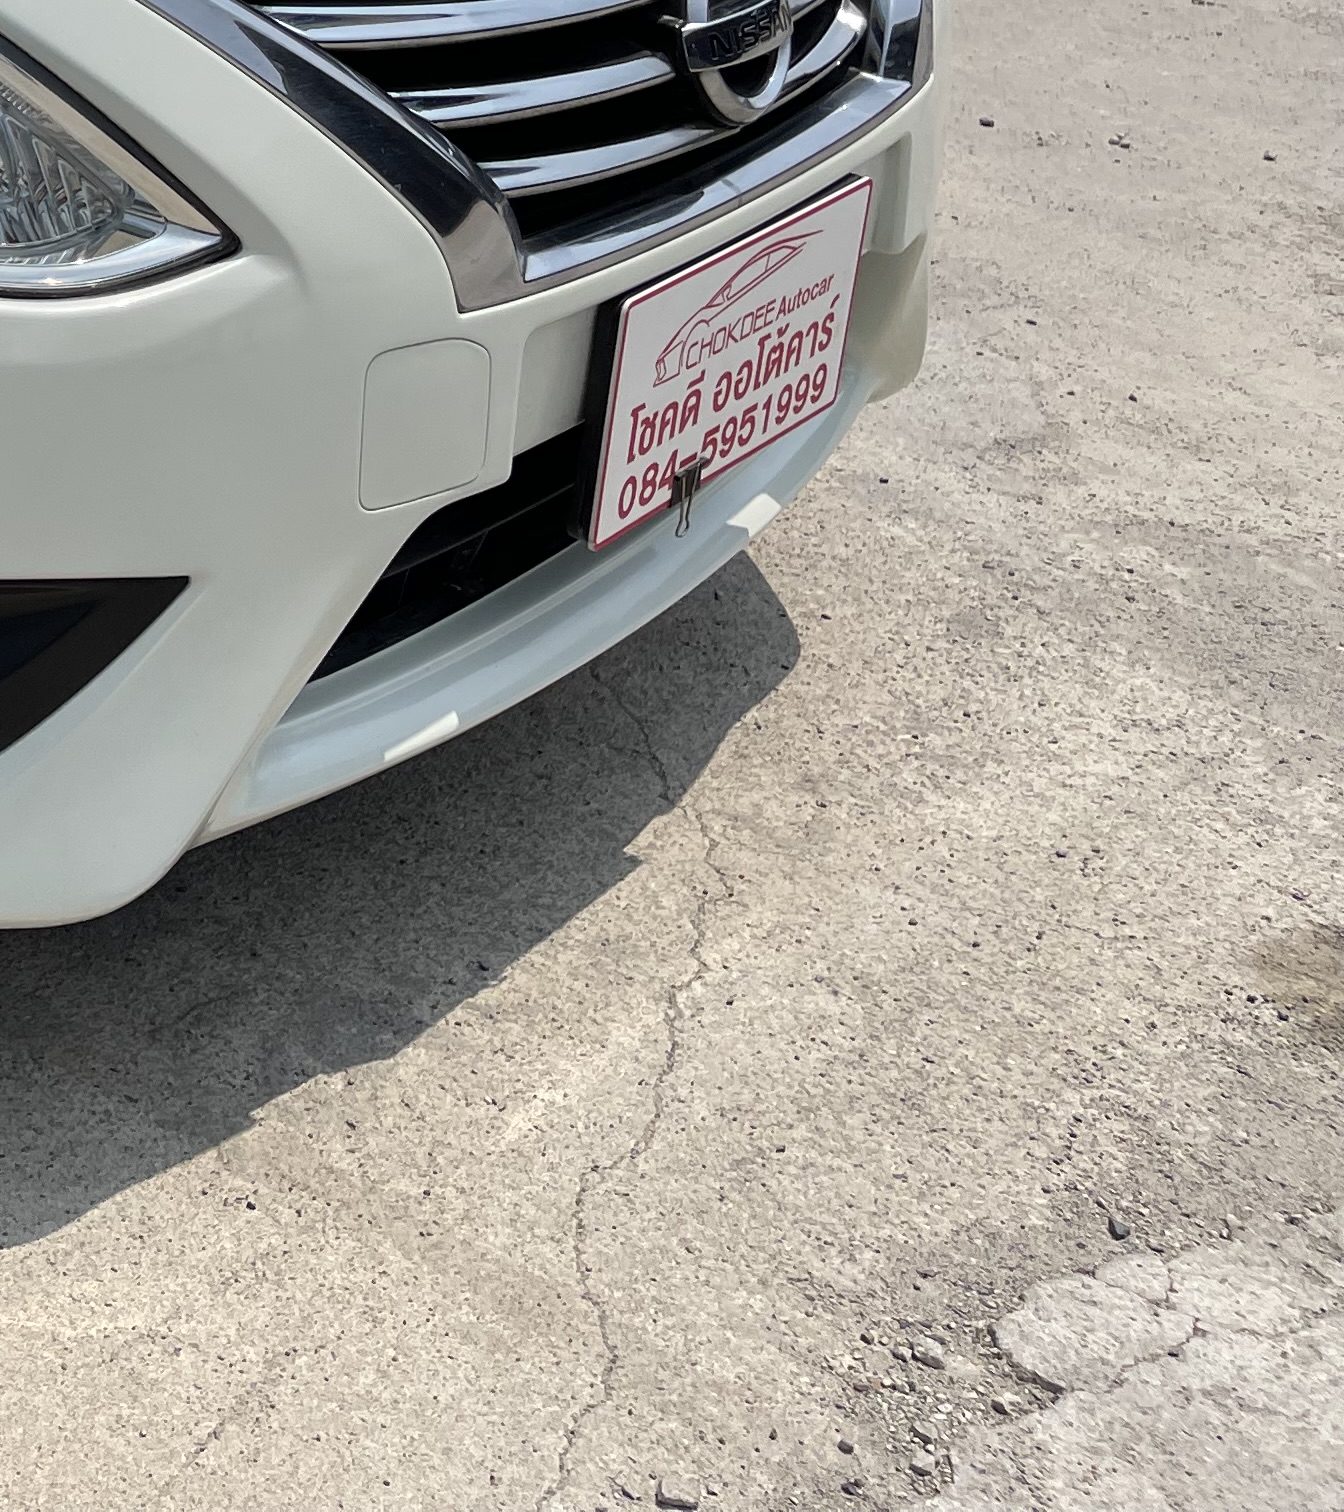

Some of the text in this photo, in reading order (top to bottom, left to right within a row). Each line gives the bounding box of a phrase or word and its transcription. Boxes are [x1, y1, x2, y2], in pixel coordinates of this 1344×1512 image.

[708, 3, 792, 61] NISSAN
[627, 293, 841, 465] โชคดี ออโต้คาร์
[685, 273, 835, 370] CHOKDEE Autocar
[618, 363, 828, 520] 084-5951999
